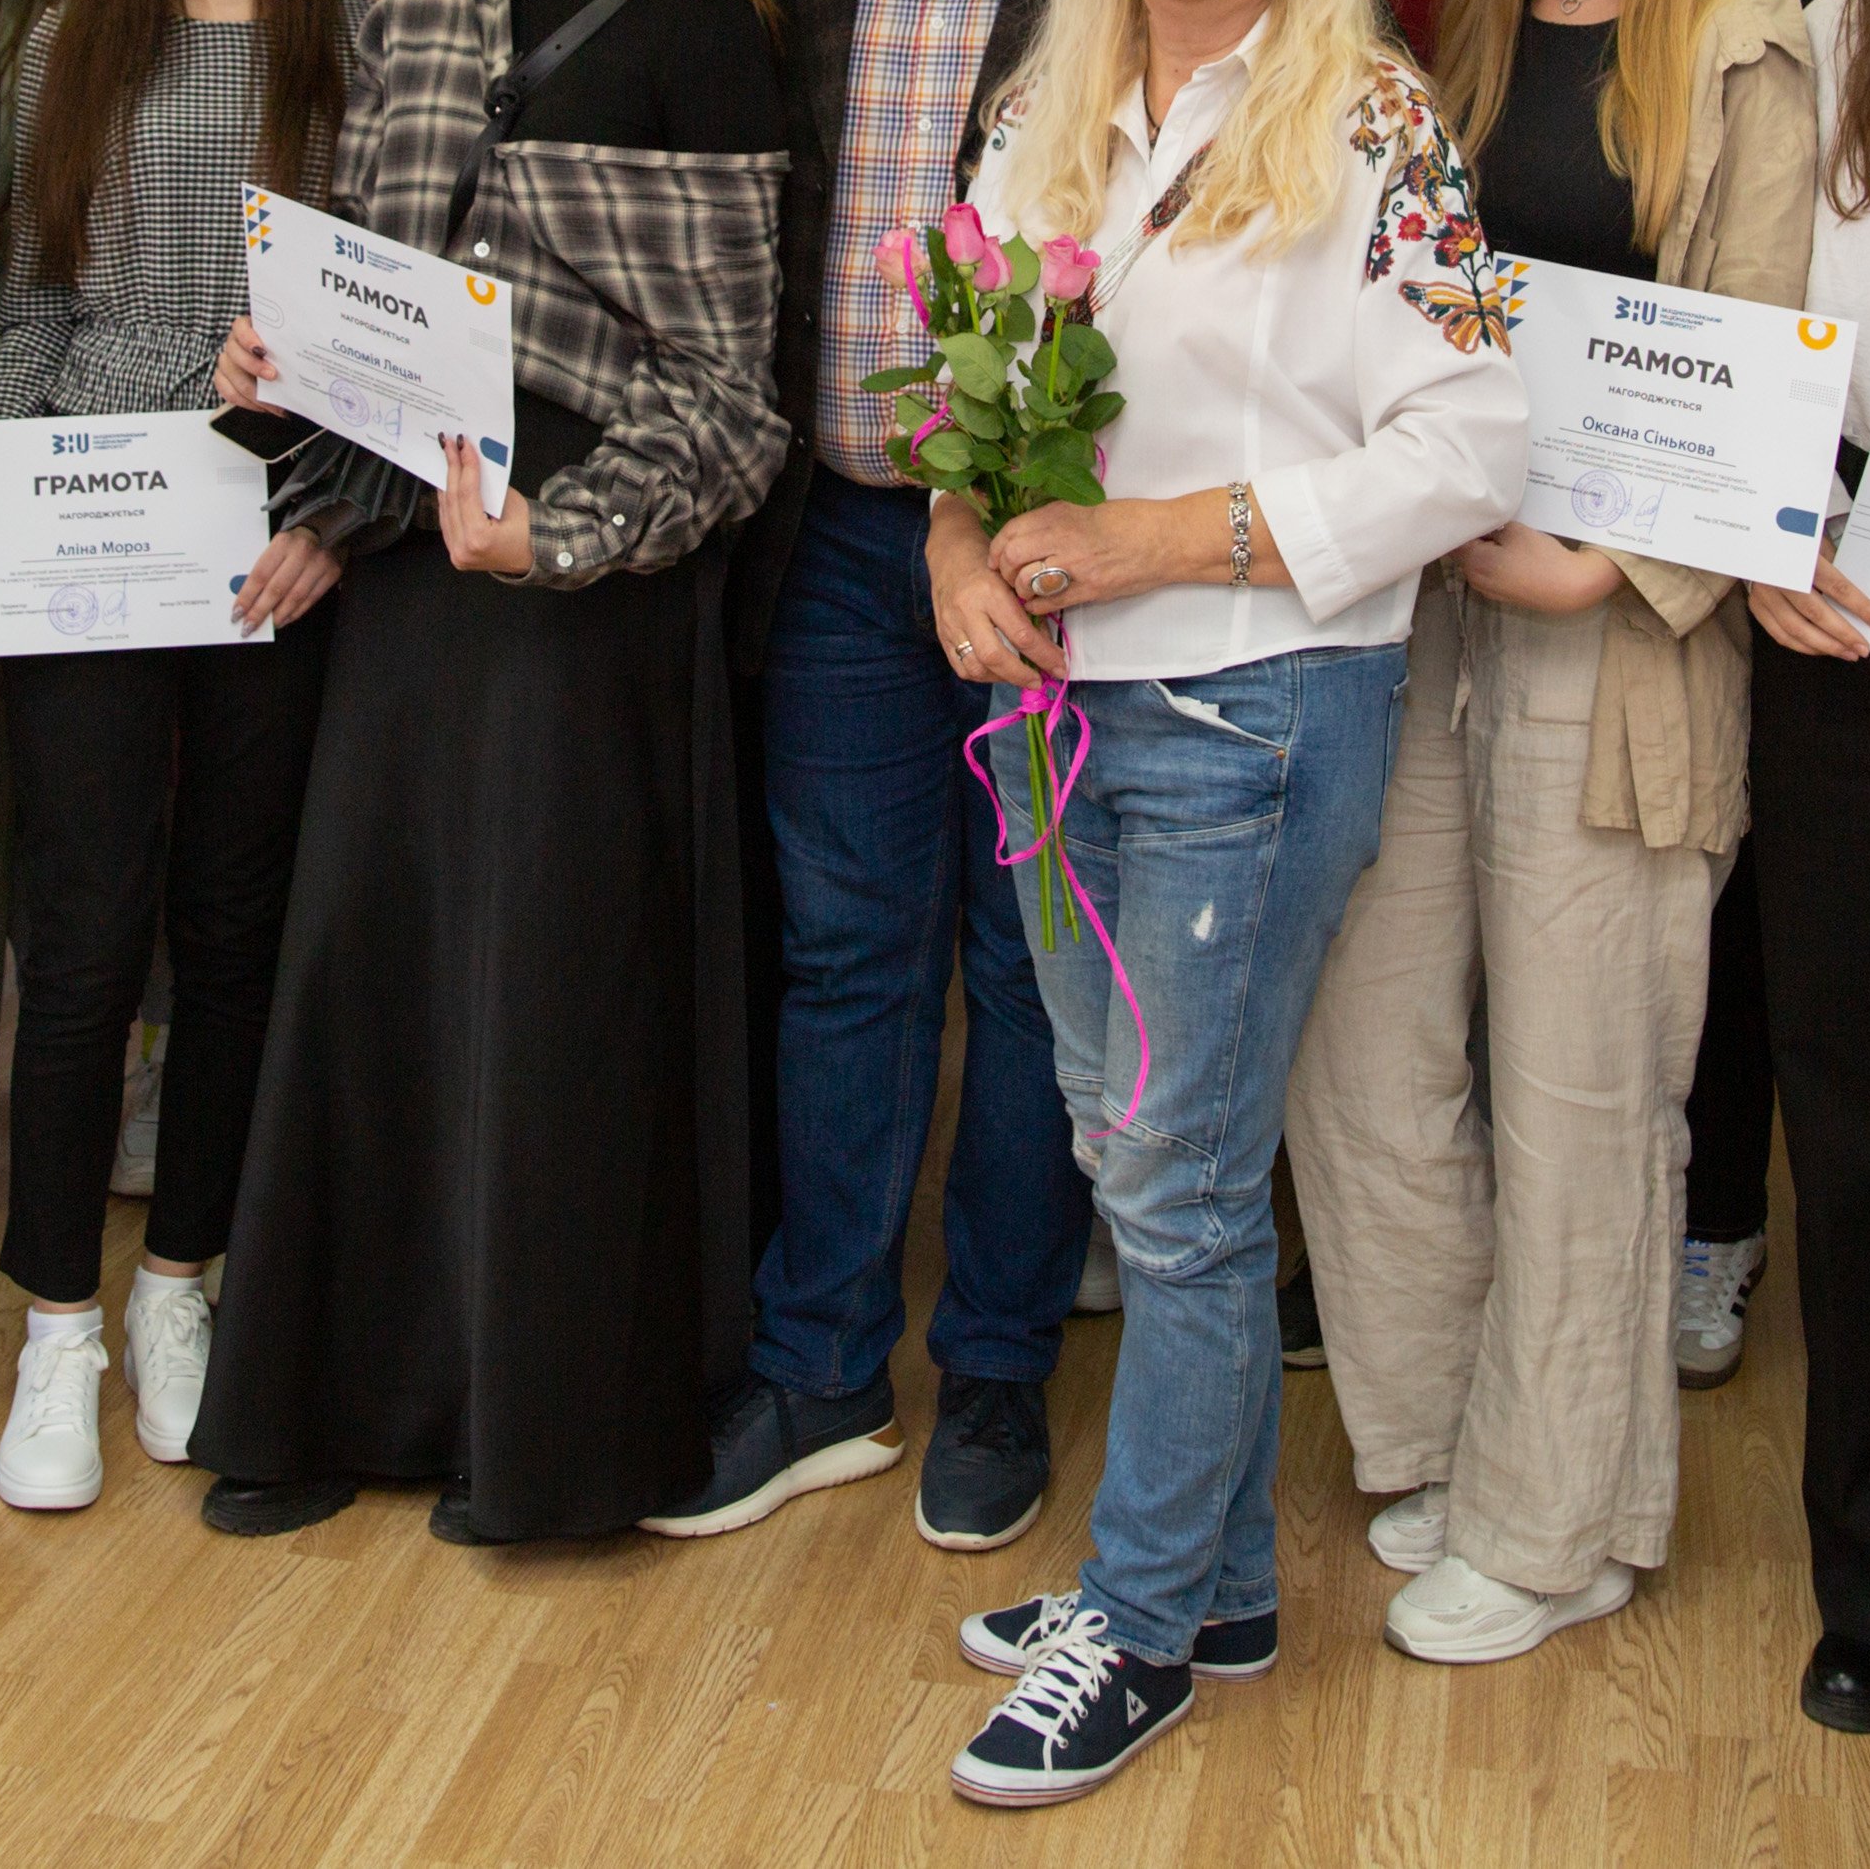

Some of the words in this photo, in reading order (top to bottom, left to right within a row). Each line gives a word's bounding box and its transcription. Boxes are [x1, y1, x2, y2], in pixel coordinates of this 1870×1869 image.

[321, 268, 428, 328] ГРАМОТА
[331, 338, 380, 367] Соломія
[382, 358, 421, 386] Лецан
[1587, 337, 1733, 388] ГРАМОТА
[1582, 415, 1638, 440] Оксана
[1643, 429, 1715, 456] Сінькова
[34, 470, 167, 495] ГРАМОТА
[56, 543, 96, 555] Аліна
[101, 541, 150, 557] Мороз
